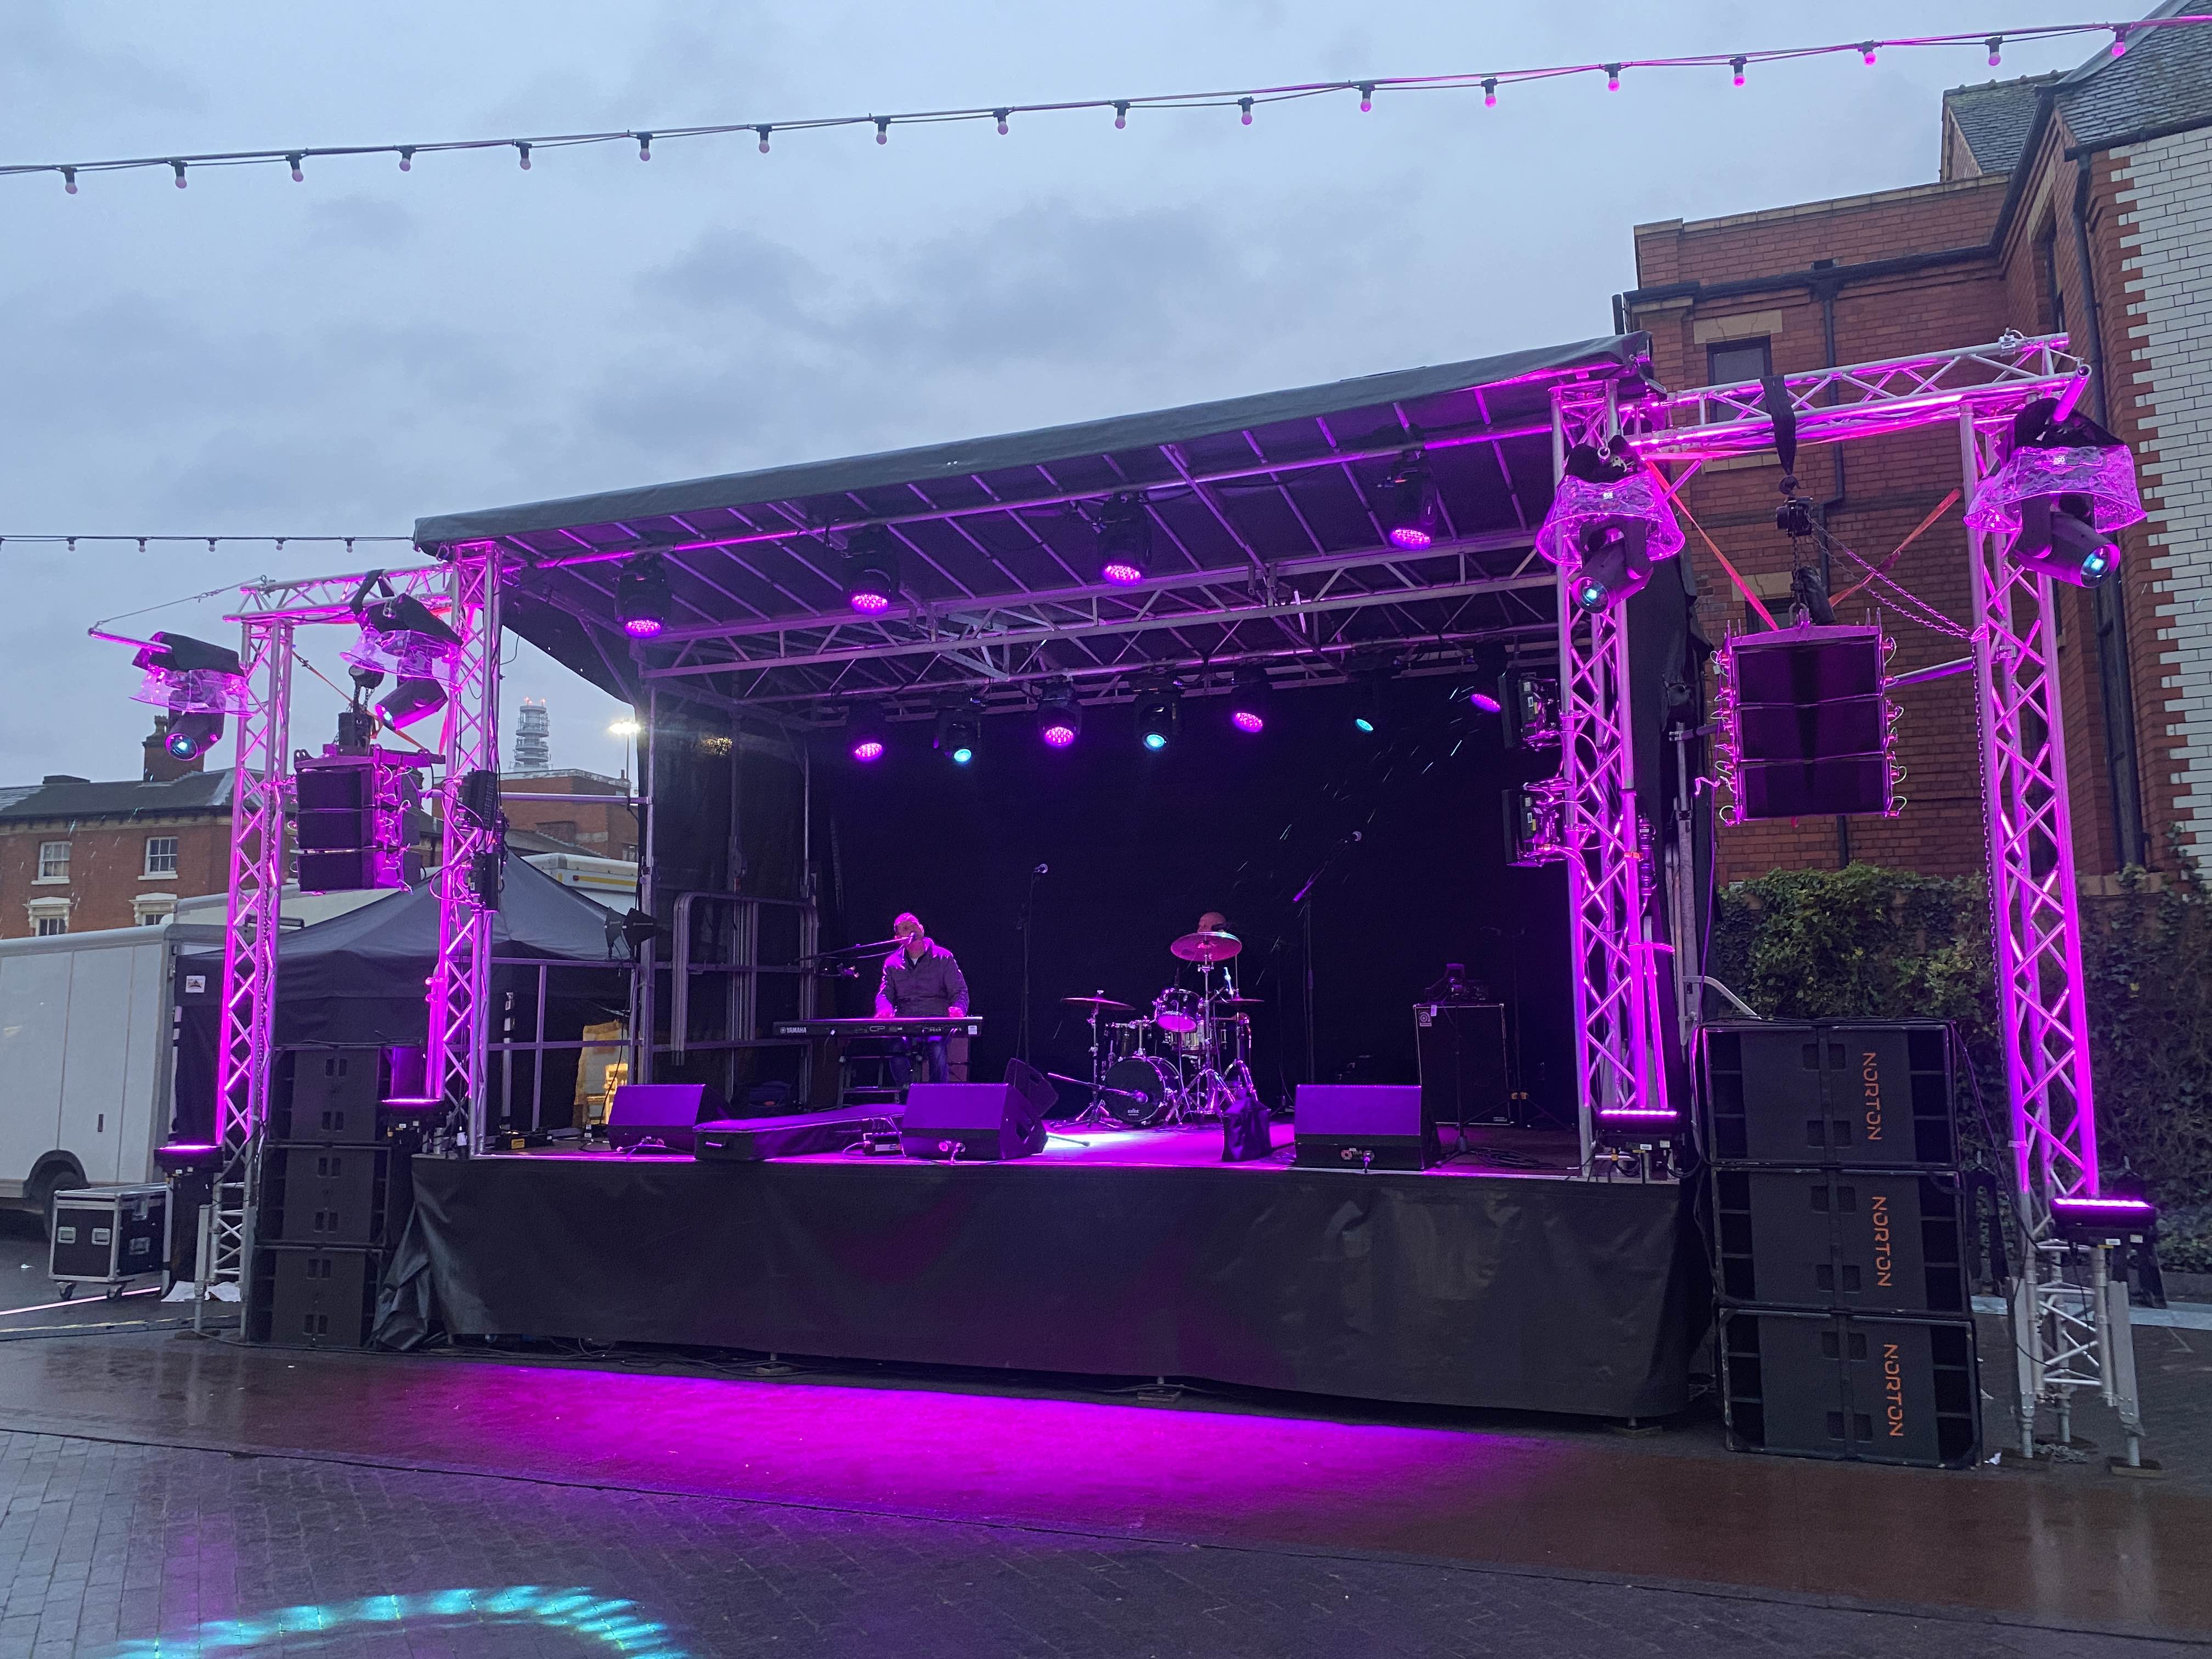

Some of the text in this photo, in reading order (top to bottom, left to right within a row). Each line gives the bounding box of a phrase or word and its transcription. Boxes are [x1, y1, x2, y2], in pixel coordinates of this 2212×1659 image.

[1863, 1053, 1882, 1141] NORTON
[1872, 1196, 1892, 1286] NORTON
[1883, 1344, 1903, 1436] NORTON
